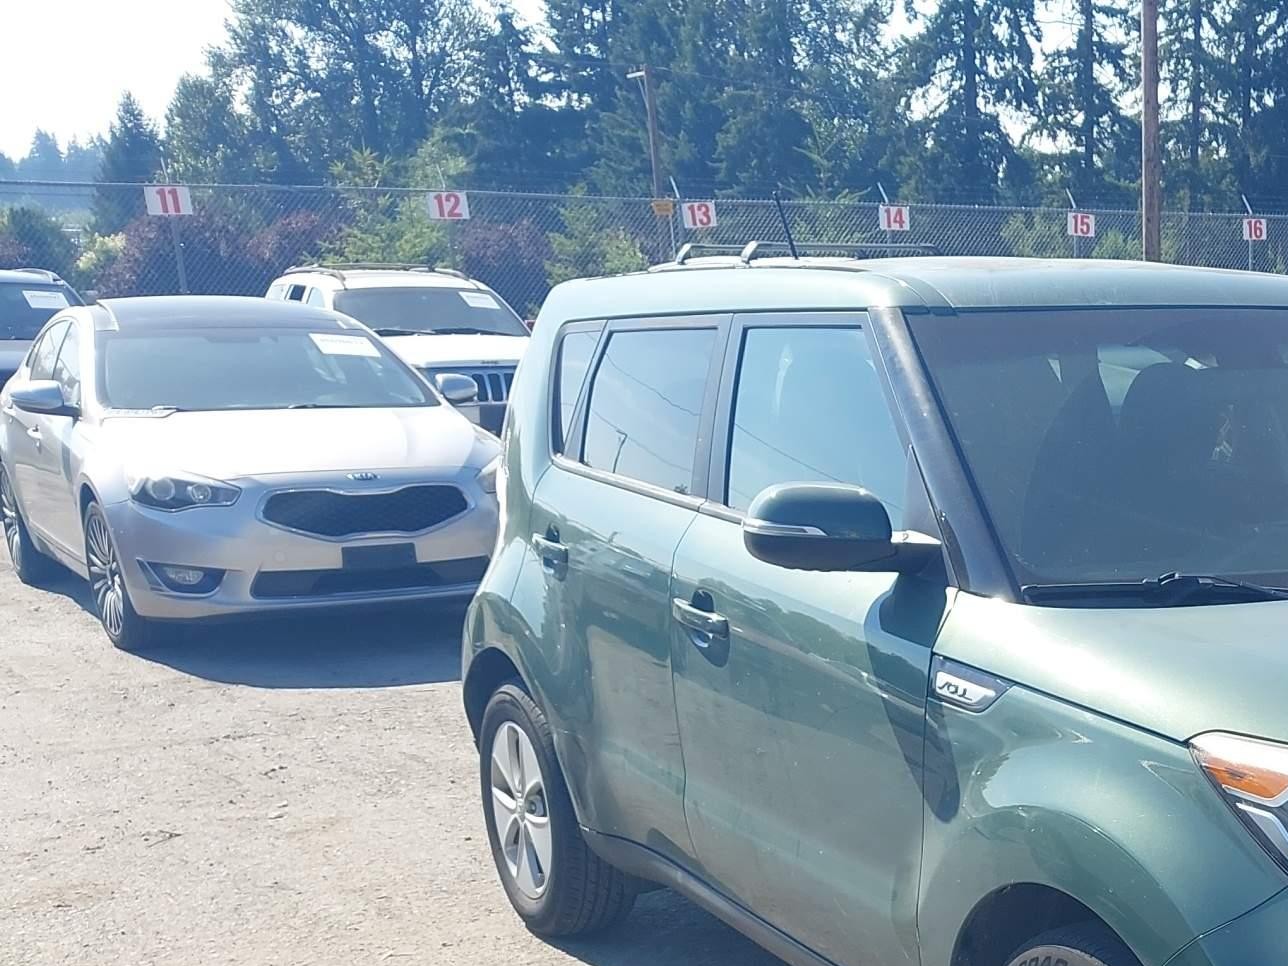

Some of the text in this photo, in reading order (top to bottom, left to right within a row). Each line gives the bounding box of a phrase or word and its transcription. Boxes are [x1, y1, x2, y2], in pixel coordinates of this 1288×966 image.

[155, 187, 182, 214] 11
[433, 192, 464, 218] 12
[687, 203, 712, 227] 13
[884, 207, 906, 229] 14
[1072, 214, 1091, 235] 15
[1247, 219, 1263, 239] 16
